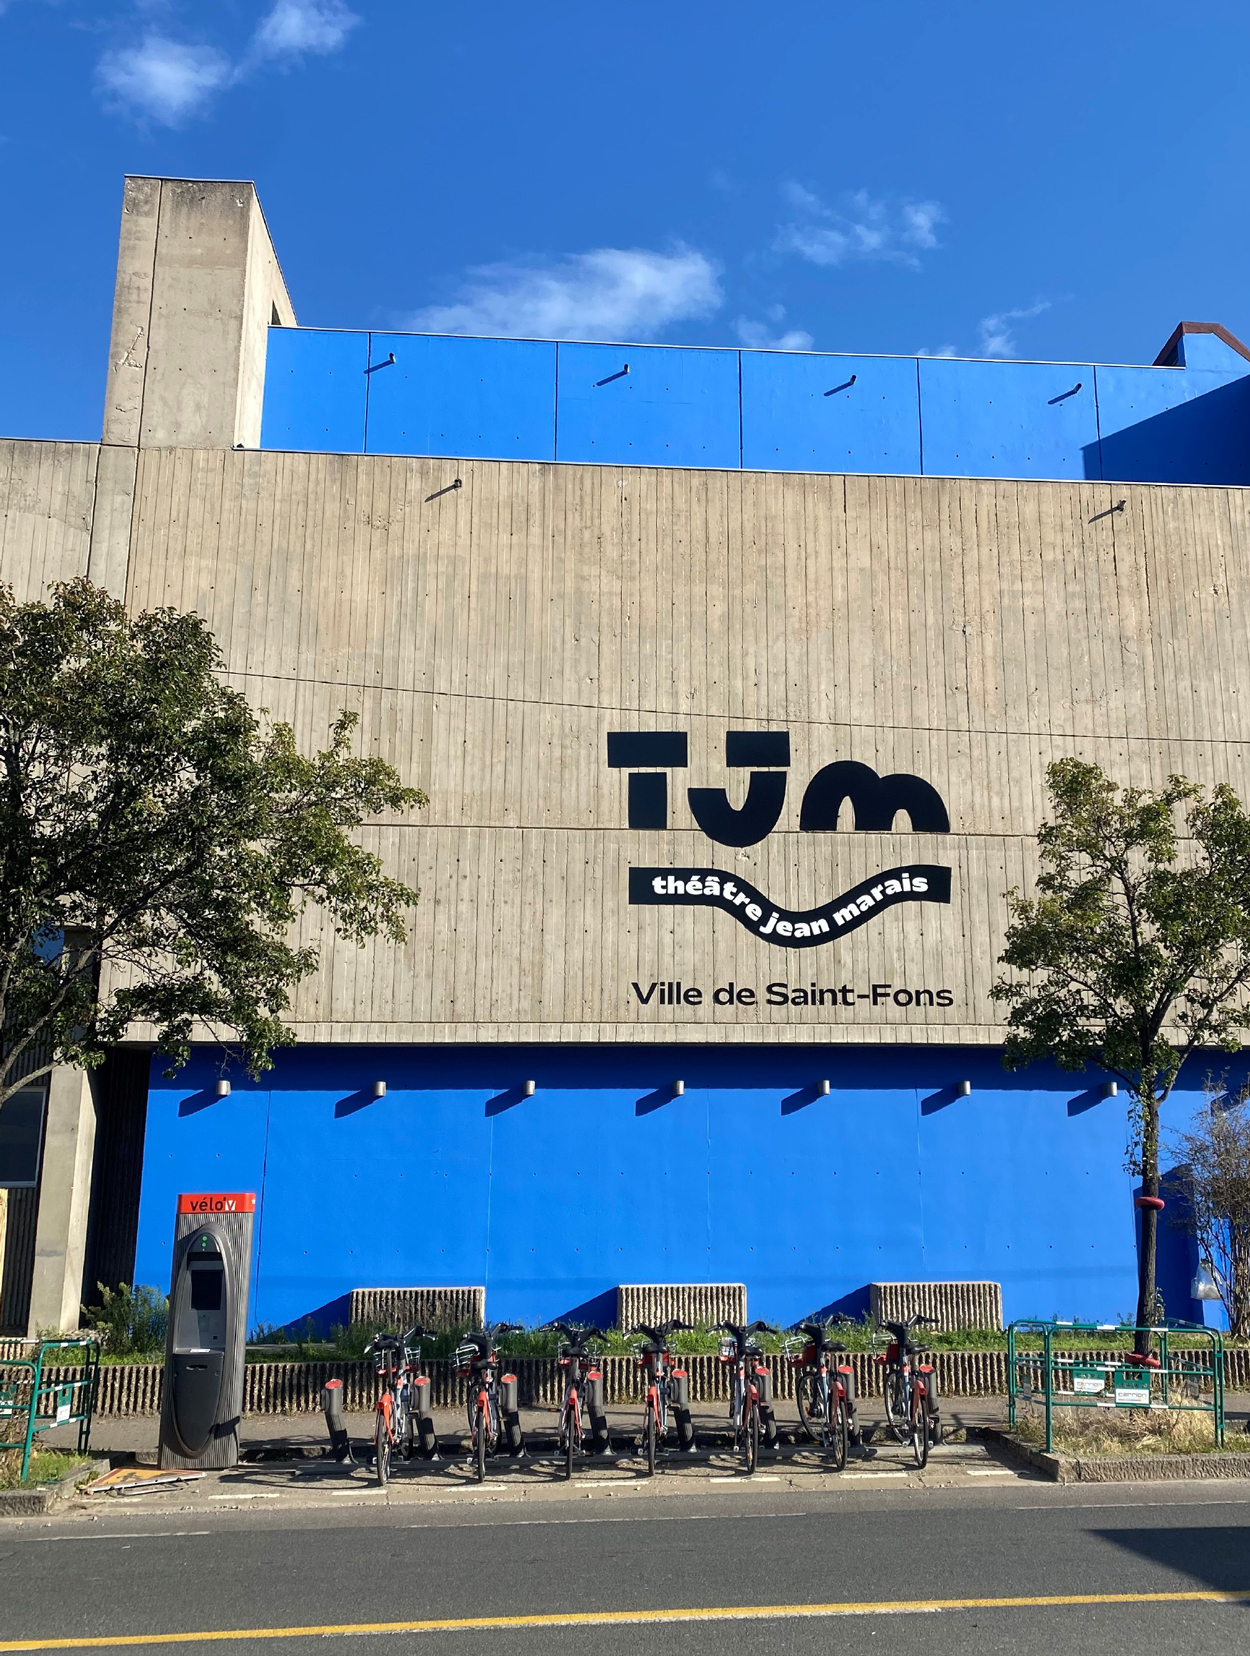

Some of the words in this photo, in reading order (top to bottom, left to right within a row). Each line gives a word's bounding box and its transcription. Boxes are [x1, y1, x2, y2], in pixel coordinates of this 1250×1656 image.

[652, 874, 762, 921] théâtre
[759, 912, 830, 938] jean
[833, 872, 929, 927] marais
[631, 981, 702, 1005] Ville
[713, 982, 756, 1006] de
[765, 982, 954, 1007] Saint-Fons
